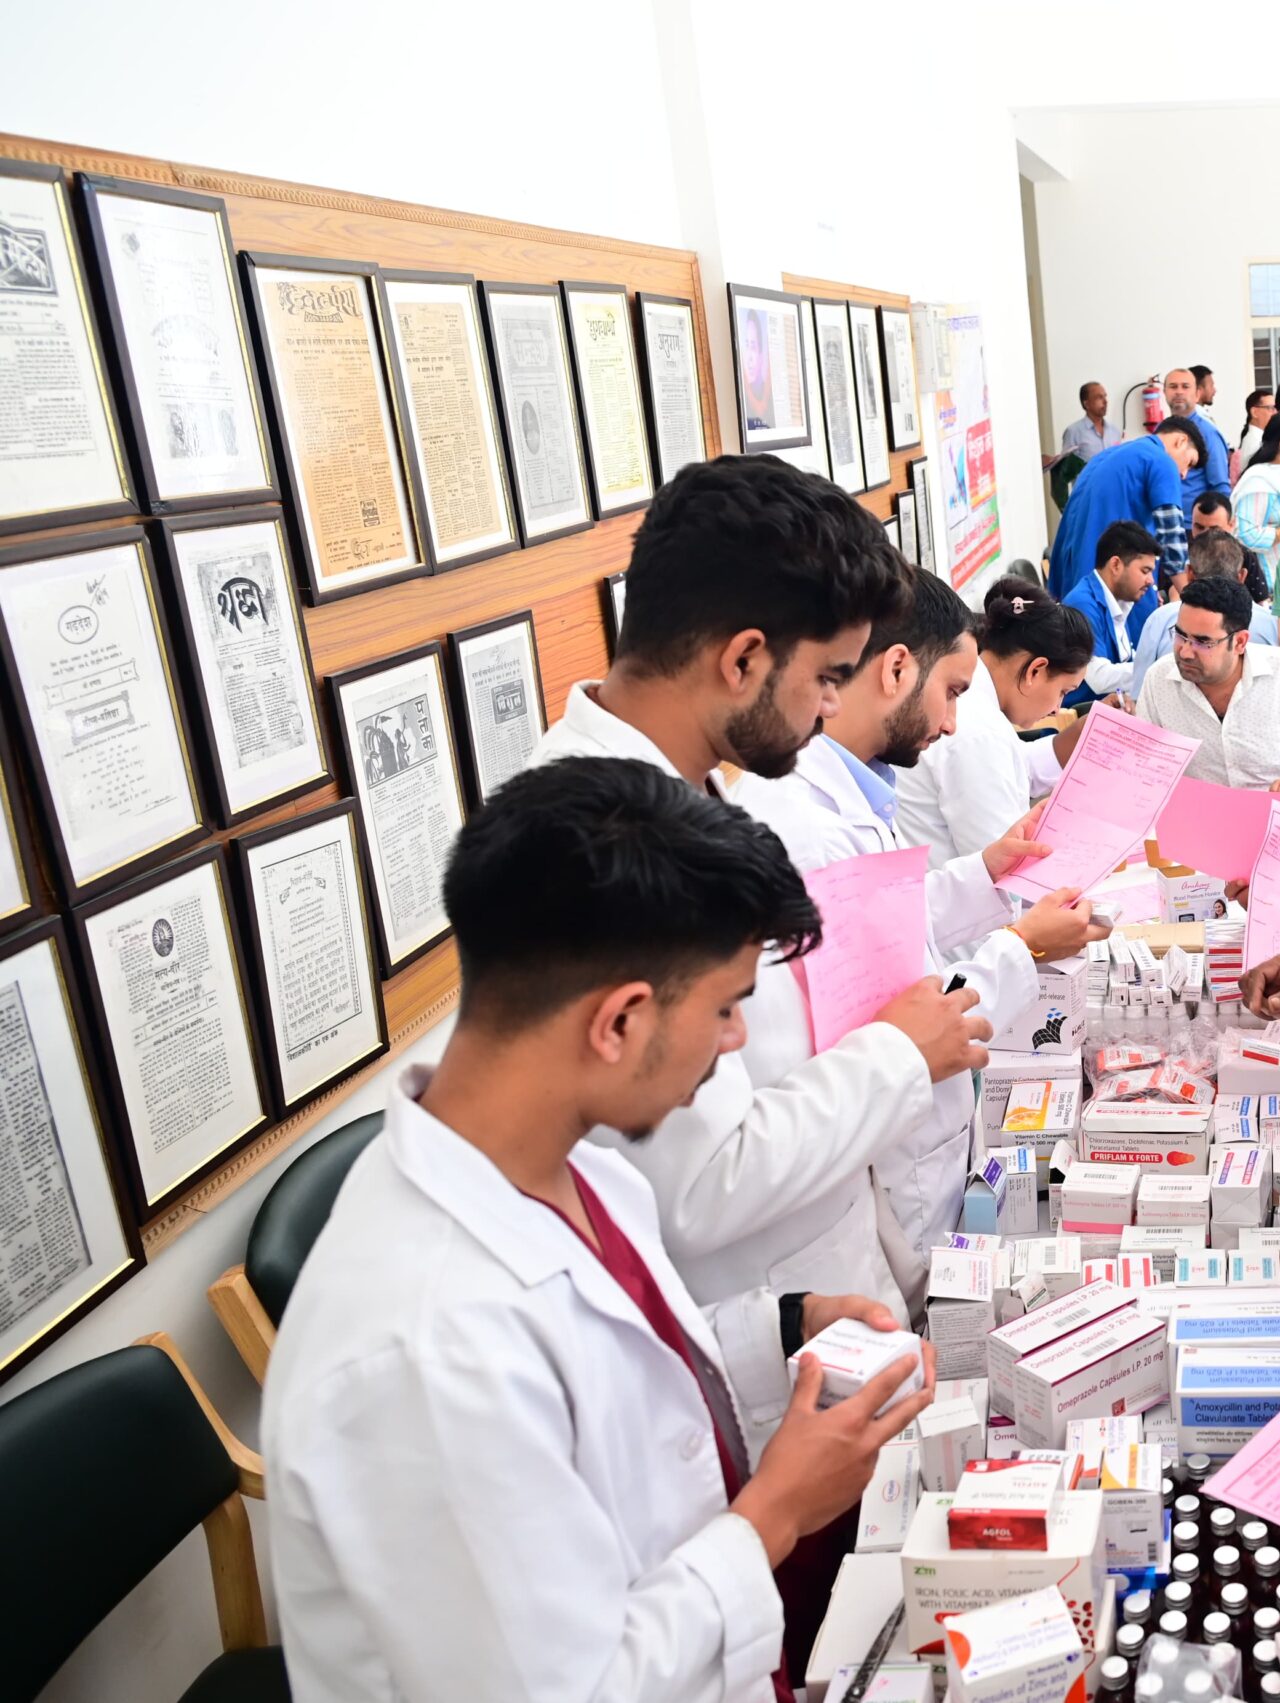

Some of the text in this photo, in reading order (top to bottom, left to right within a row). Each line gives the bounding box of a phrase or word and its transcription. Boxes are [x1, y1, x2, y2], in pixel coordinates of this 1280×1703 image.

[1094, 1152, 1127, 1160] PRIFLAM
[1136, 1154, 1159, 1162] FORTE
[1003, 1315, 1047, 1338] Omeprazole
[1047, 1299, 1079, 1318] Capsules
[1100, 1284, 1113, 1294] mg
[1030, 1344, 1074, 1369] Omeprazole
[1074, 1328, 1105, 1349] Capsules
[1117, 1317, 1127, 1327] 20
[1127, 1313, 1140, 1323] mg
[1057, 1350, 1164, 1413] Omeprazole Capsules I.P. 20 mg
[1195, 1403, 1243, 1412] Amoxycillin
[1245, 1403, 1260, 1411] and
[1195, 1413, 1246, 1422] Clavulanate
[982, 1528, 1012, 1537] AGFOL
[915, 1588, 939, 1598] IRON,
[943, 1589, 968, 1597] FOLIC
[973, 1589, 995, 1598] ACID,
[944, 1601, 982, 1609] VITAMIN
[1028, 1676, 1048, 1691] Zinc
[1049, 1670, 1067, 1684] and
